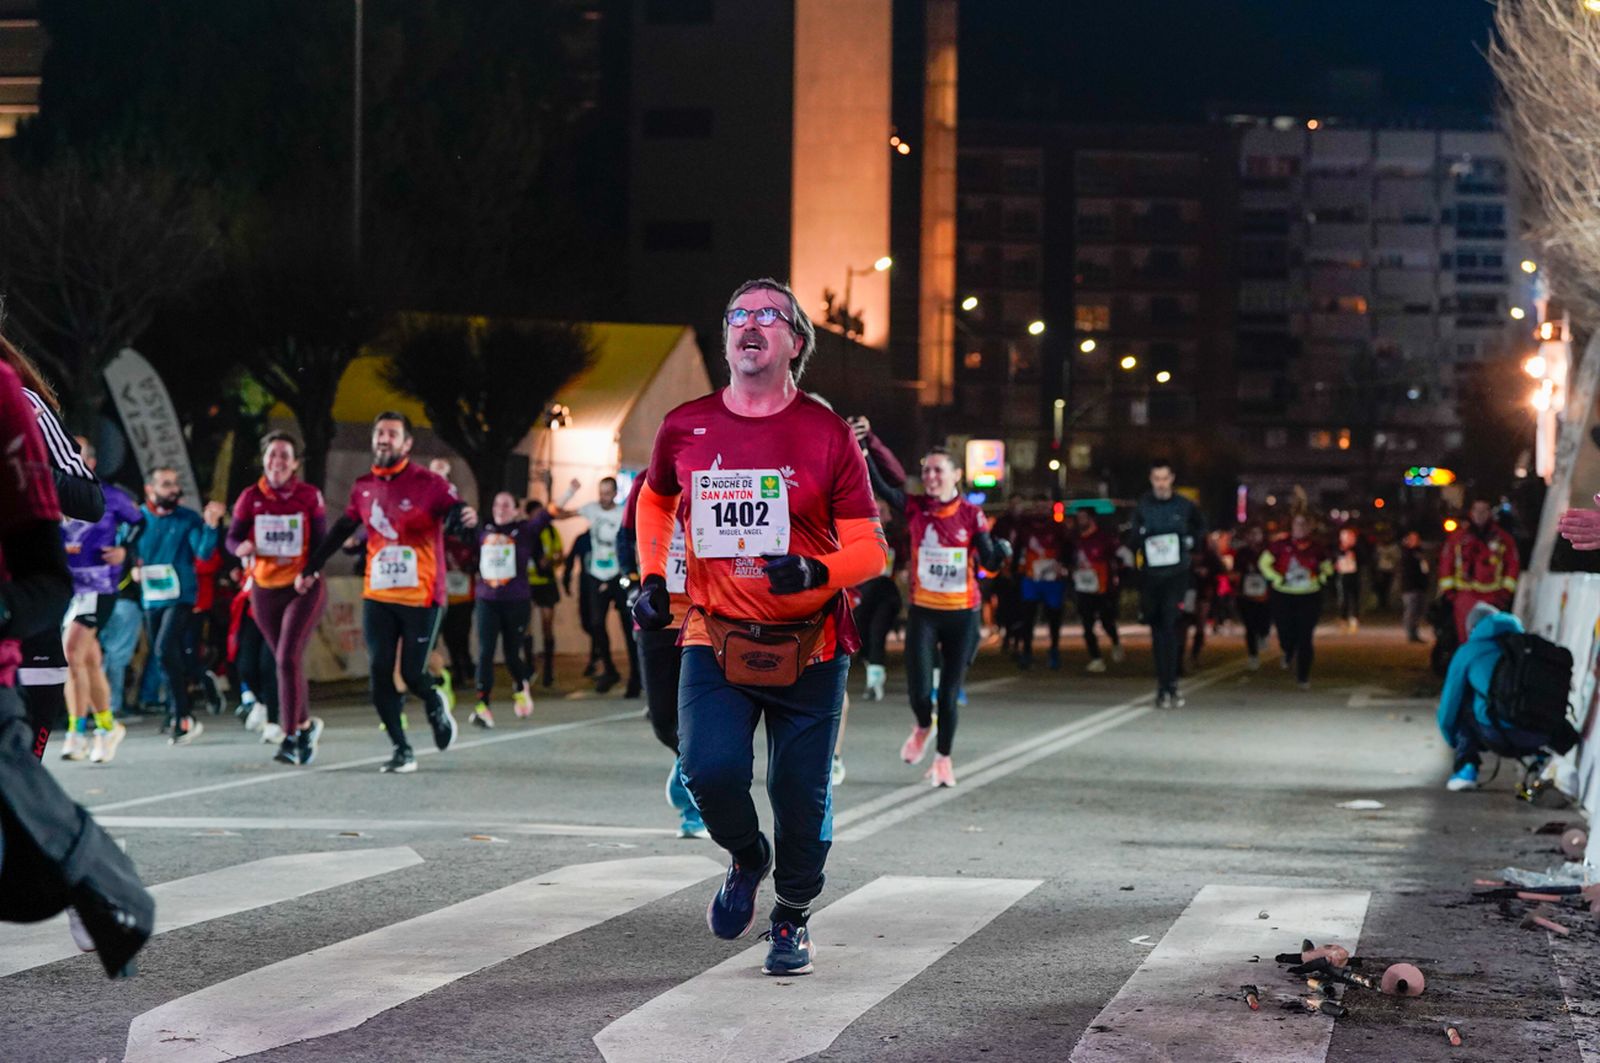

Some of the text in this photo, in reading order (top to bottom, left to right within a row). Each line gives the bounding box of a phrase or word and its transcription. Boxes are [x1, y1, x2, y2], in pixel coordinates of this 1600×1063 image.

[712, 479, 753, 489] NOCHE DE
[701, 490, 720, 500] SAN
[711, 501, 769, 527] 1402
[719, 528, 741, 536] MIGUEL
[735, 557, 755, 567] SAN
